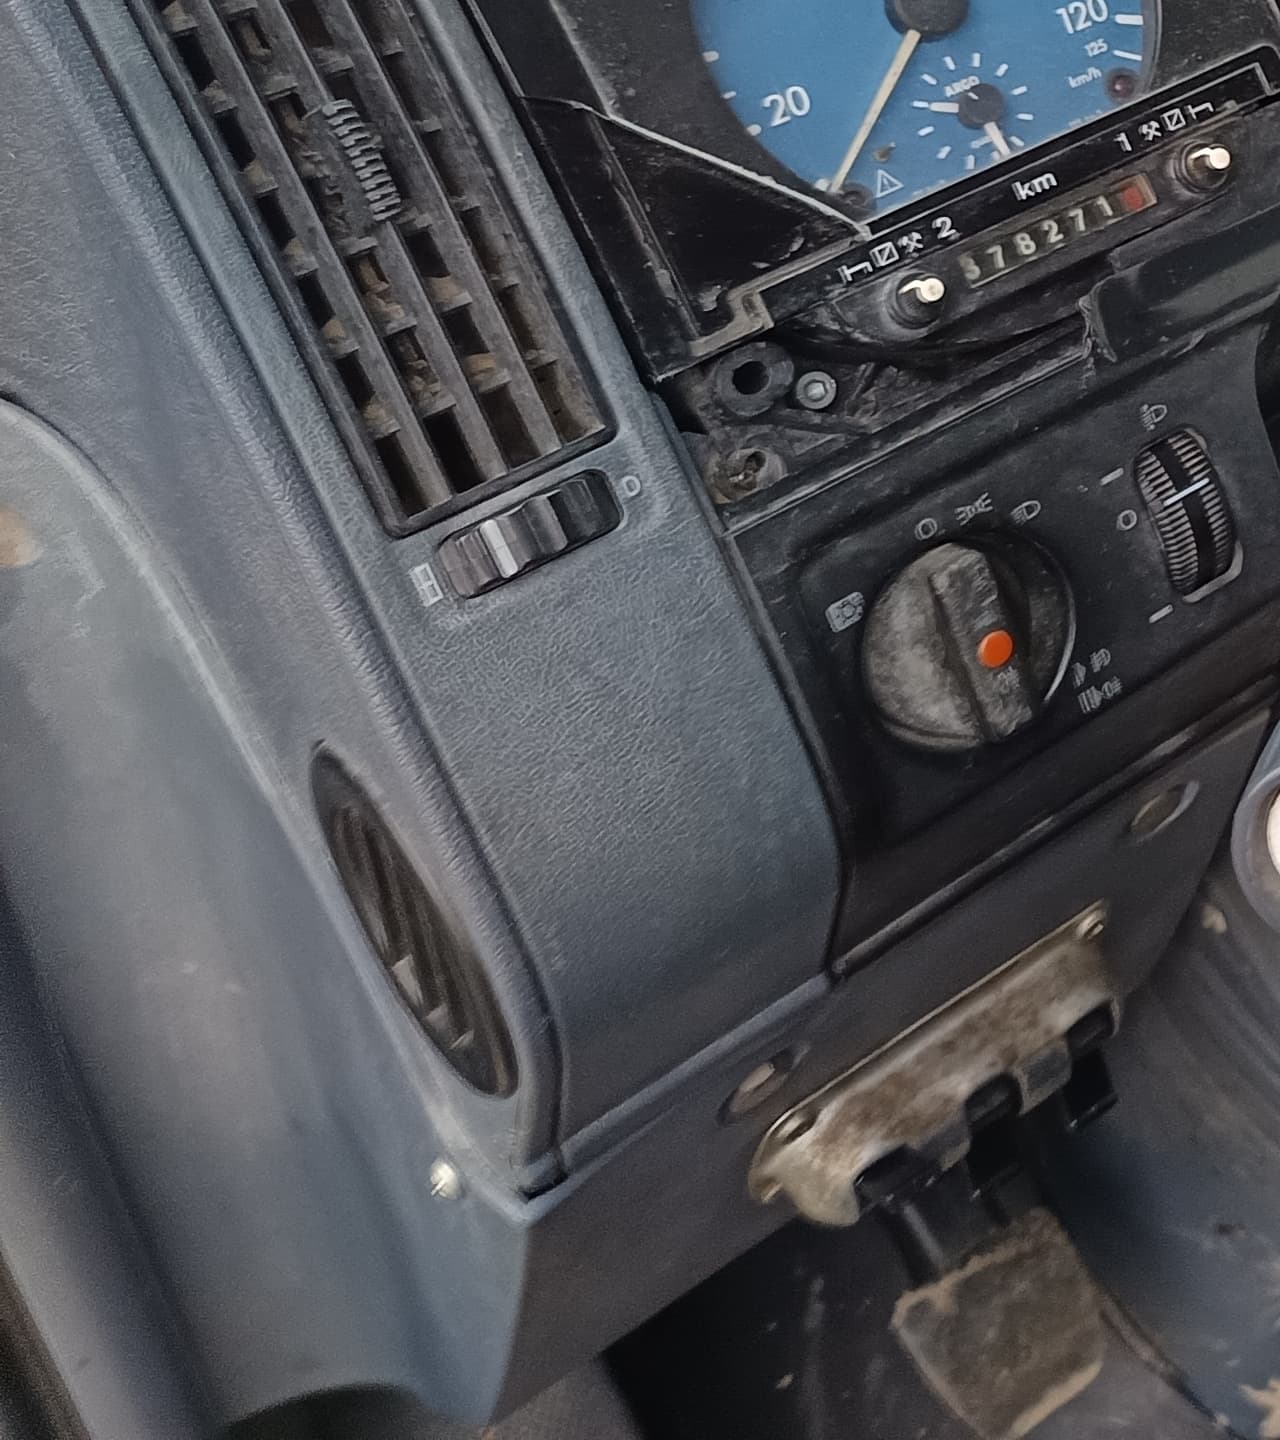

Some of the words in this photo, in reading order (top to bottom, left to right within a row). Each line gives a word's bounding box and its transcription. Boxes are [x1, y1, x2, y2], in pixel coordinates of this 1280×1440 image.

[1083, 37, 1109, 58] 125
[1067, 65, 1102, 89] km/h
[761, 85, 812, 128] 20
[1011, 172, 1059, 201] km
